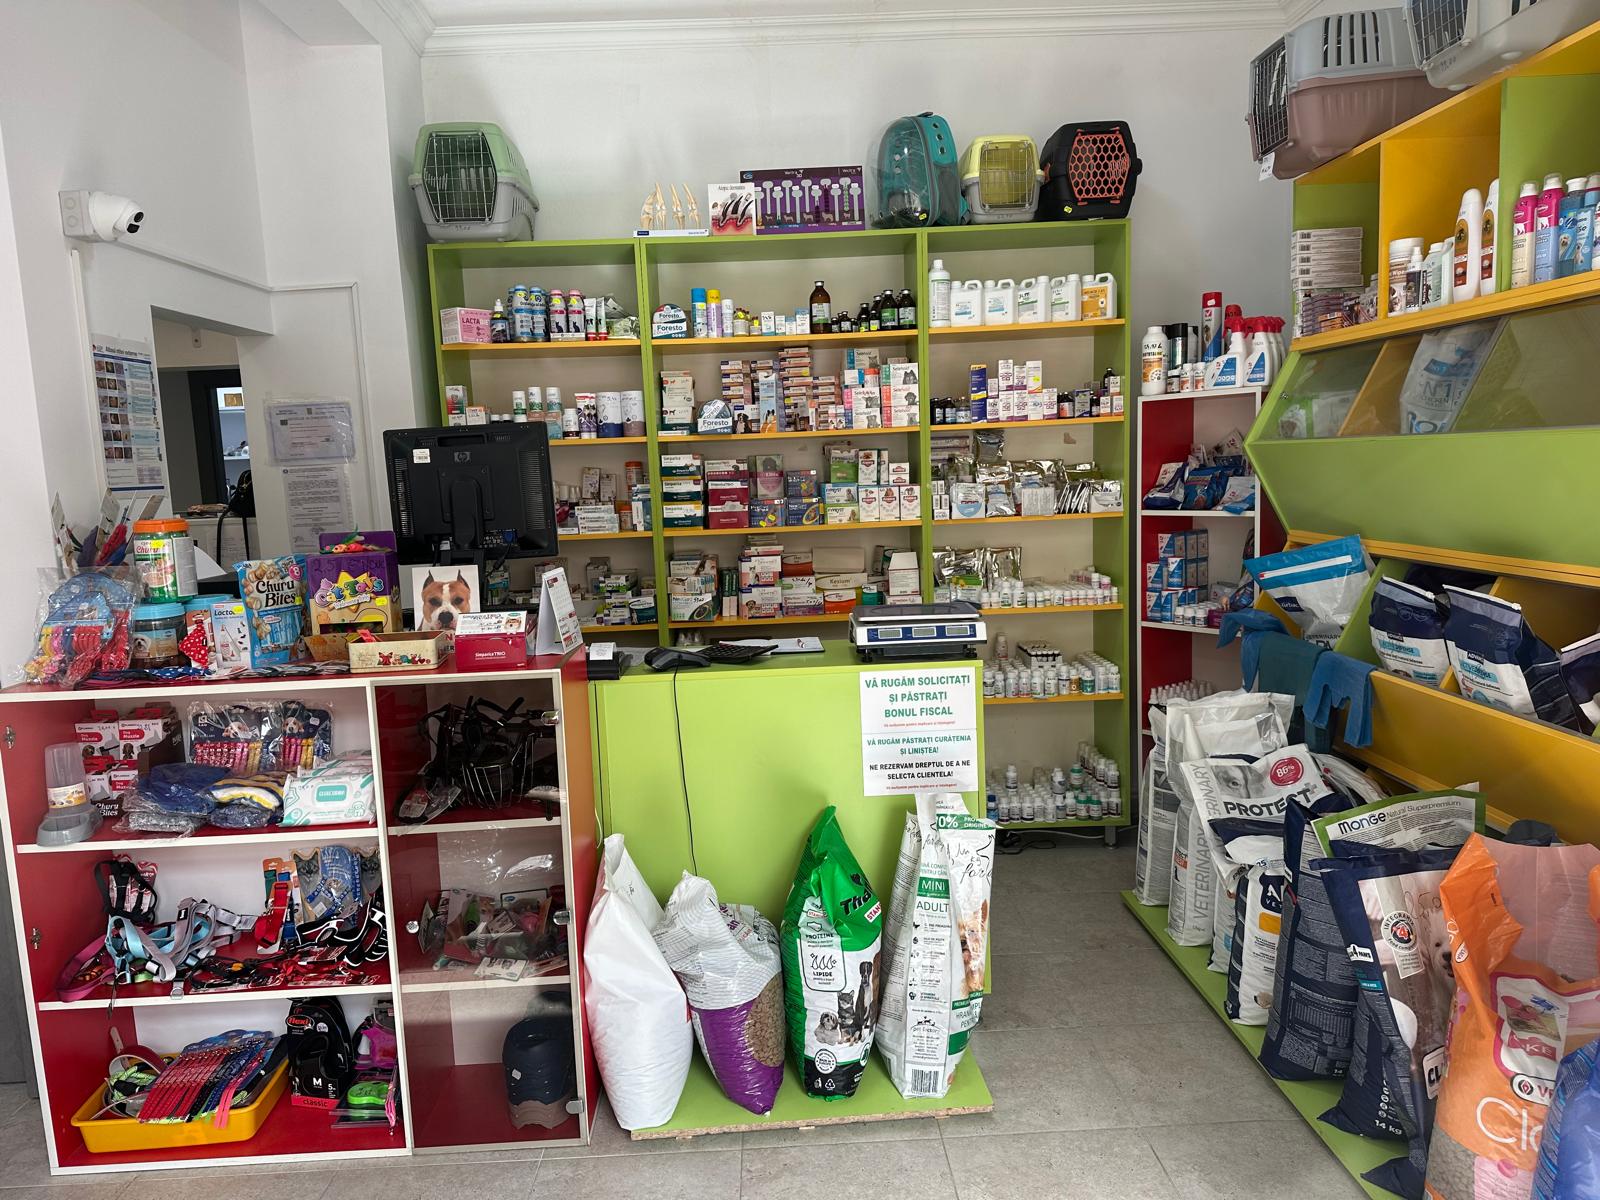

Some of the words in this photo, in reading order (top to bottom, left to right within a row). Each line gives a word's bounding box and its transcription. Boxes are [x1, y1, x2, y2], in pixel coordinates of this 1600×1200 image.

[293, 566, 300, 576] 8
[256, 580, 295, 594] Churu
[265, 592, 296, 608] Bites
[865, 678, 879, 689] VĂ
[881, 676, 915, 688] RUGĂM
[918, 675, 970, 687] SOLICITAȚI
[889, 694, 898, 704] ȘI
[901, 691, 947, 704] PĂSTRAȚI
[884, 709, 917, 718] BONUL
[920, 706, 953, 717] FISCAL
[878, 737, 901, 745] RUGĂM
[902, 736, 933, 745] PĂSTRAȚI
[935, 735, 971, 744] CURĂȚENIA
[900, 748, 907, 756] ȘI
[908, 747, 939, 755] LINIȘTEA!
[880, 762, 914, 770] REZERVAM
[916, 761, 944, 769] DREPTUL
[1276, 764, 1295, 778] 86%
[888, 772, 916, 780] SELECTA
[916, 771, 953, 779] CLIENTELA!
[1386, 806, 1407, 819] Natural
[1407, 800, 1462, 812] Superpremium
[936, 816, 959, 829] 0%
[1193, 826, 1211, 921] VETERINARY
[922, 880, 945, 891] MINI
[916, 901, 949, 913] ADULT
[313, 1078, 323, 1087] M
[303, 1100, 328, 1108] classic
[1375, 1119, 1387, 1129] 14
[1389, 1124, 1402, 1135] kg
